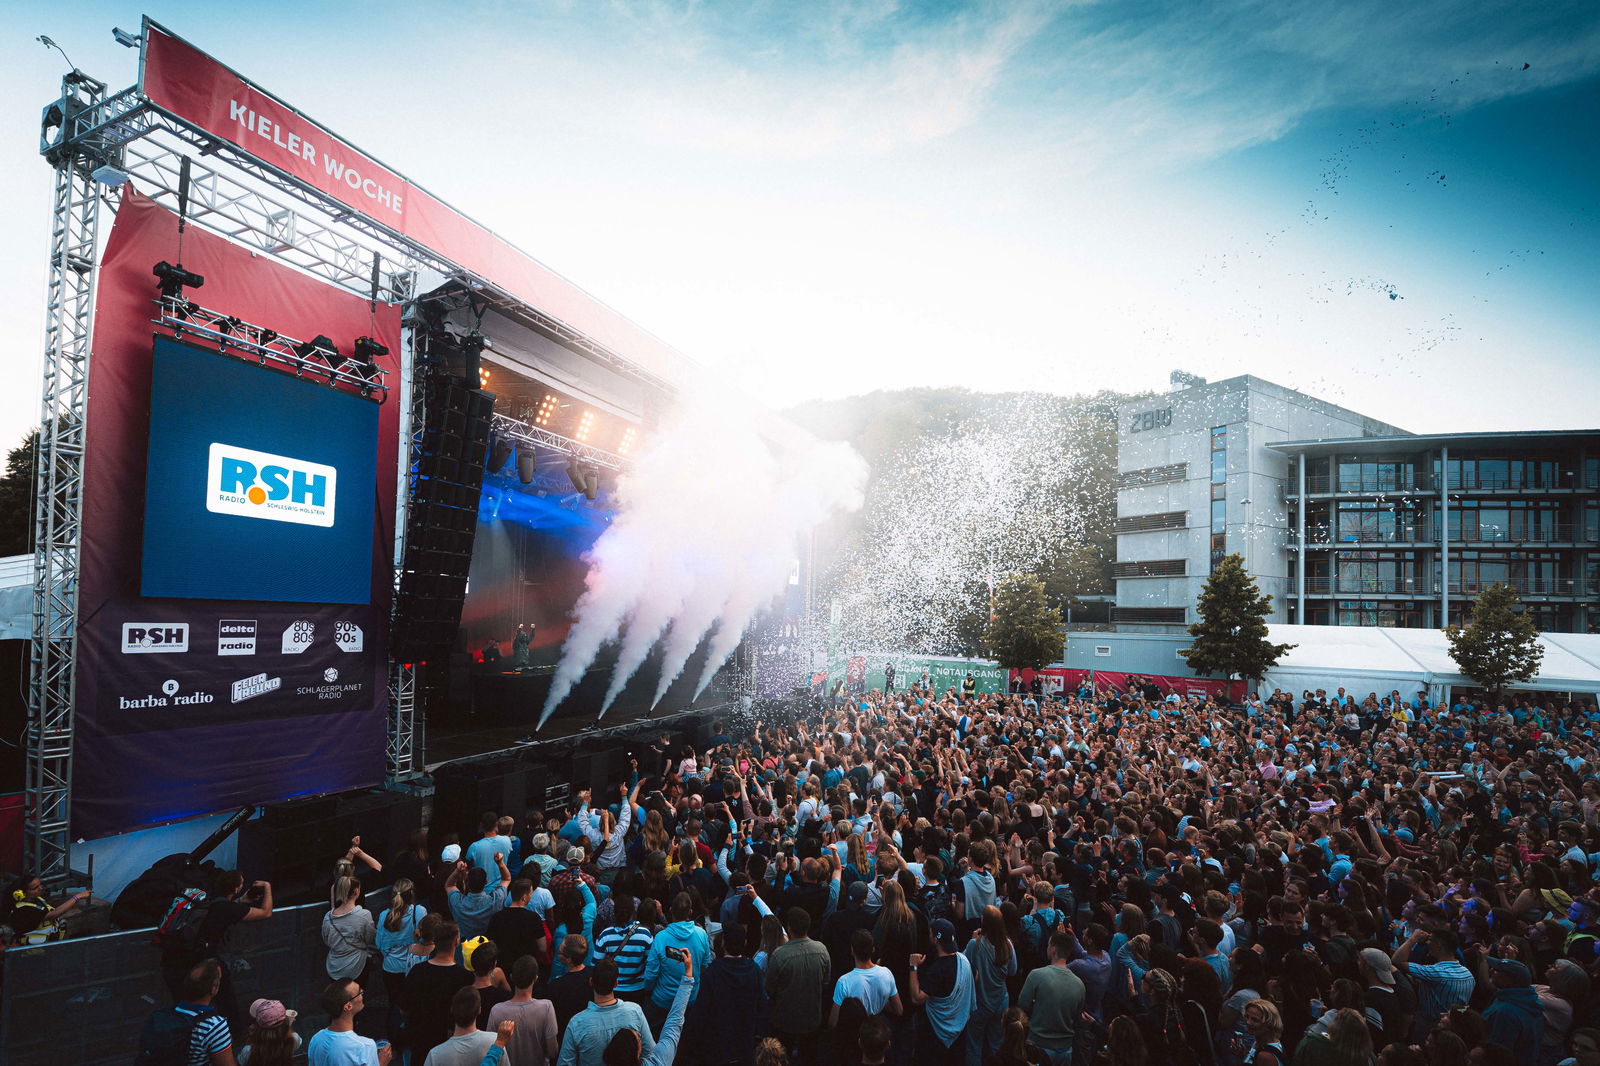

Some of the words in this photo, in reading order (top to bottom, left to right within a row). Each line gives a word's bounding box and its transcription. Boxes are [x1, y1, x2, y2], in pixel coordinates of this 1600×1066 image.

[229, 99, 316, 167] KIELER
[323, 153, 403, 215] WOCHE
[1130, 406, 1172, 433] ZBW
[220, 457, 326, 507] RSH
[219, 494, 246, 504] RADIO
[293, 620, 315, 632] 80s
[335, 621, 357, 632] 90s
[128, 628, 184, 643] RSH
[292, 632, 314, 643] 80s
[334, 632, 356, 643] 90s
[220, 642, 254, 650] radio
[936, 668, 1001, 679] NOTAUSGANG
[167, 683, 175, 691] B
[296, 683, 362, 695] SCHLAGERPLANET
[119, 694, 168, 710] barba
[174, 691, 214, 706] radio
[318, 691, 342, 700] RADIO
